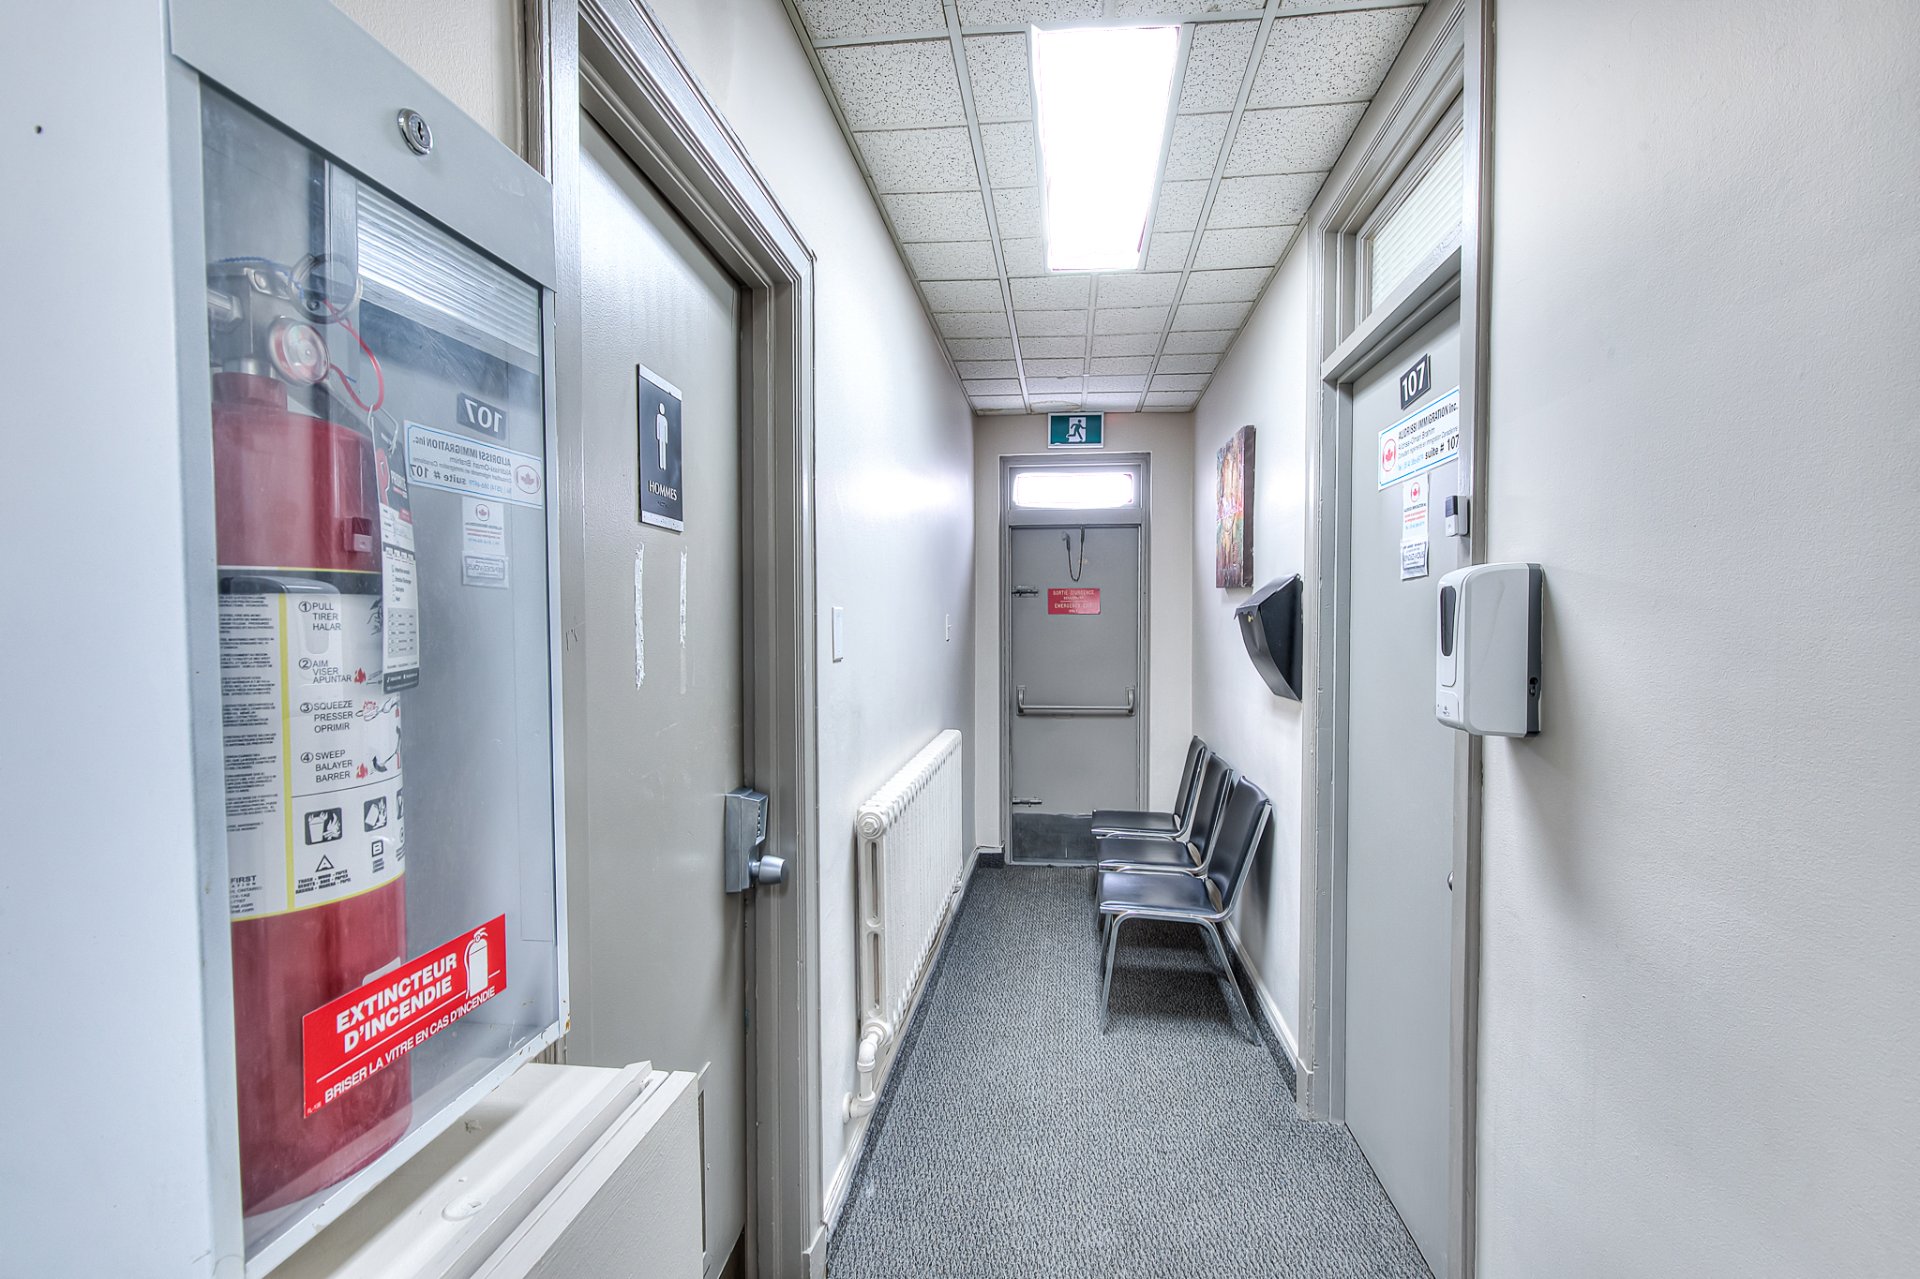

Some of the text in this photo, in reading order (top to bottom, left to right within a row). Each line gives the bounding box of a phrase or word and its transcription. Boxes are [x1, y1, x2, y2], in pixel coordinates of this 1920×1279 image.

[1401, 360, 1426, 401] 107
[1425, 434, 1459, 459] suite # 107
[649, 480, 677, 501] HOMMES
[312, 602, 334, 611] PULL
[312, 612, 339, 621] TIRER
[312, 622, 341, 631] HALAR
[312, 667, 339, 676] VISER
[312, 674, 352, 684] APUNTAR
[313, 700, 353, 711] SQUEEZE
[314, 711, 353, 721] PRESSER
[314, 722, 350, 733] OPRIMIR
[315, 749, 346, 761] SWEEP
[315, 759, 353, 772] BALAYER
[316, 771, 350, 783] BARRER
[336, 952, 458, 1034] EXTINCTEUR
[344, 974, 453, 1054] D'INCENDIE
[325, 986, 496, 1103] BRISER LA VITRE EN CAS D'INCENDIE
